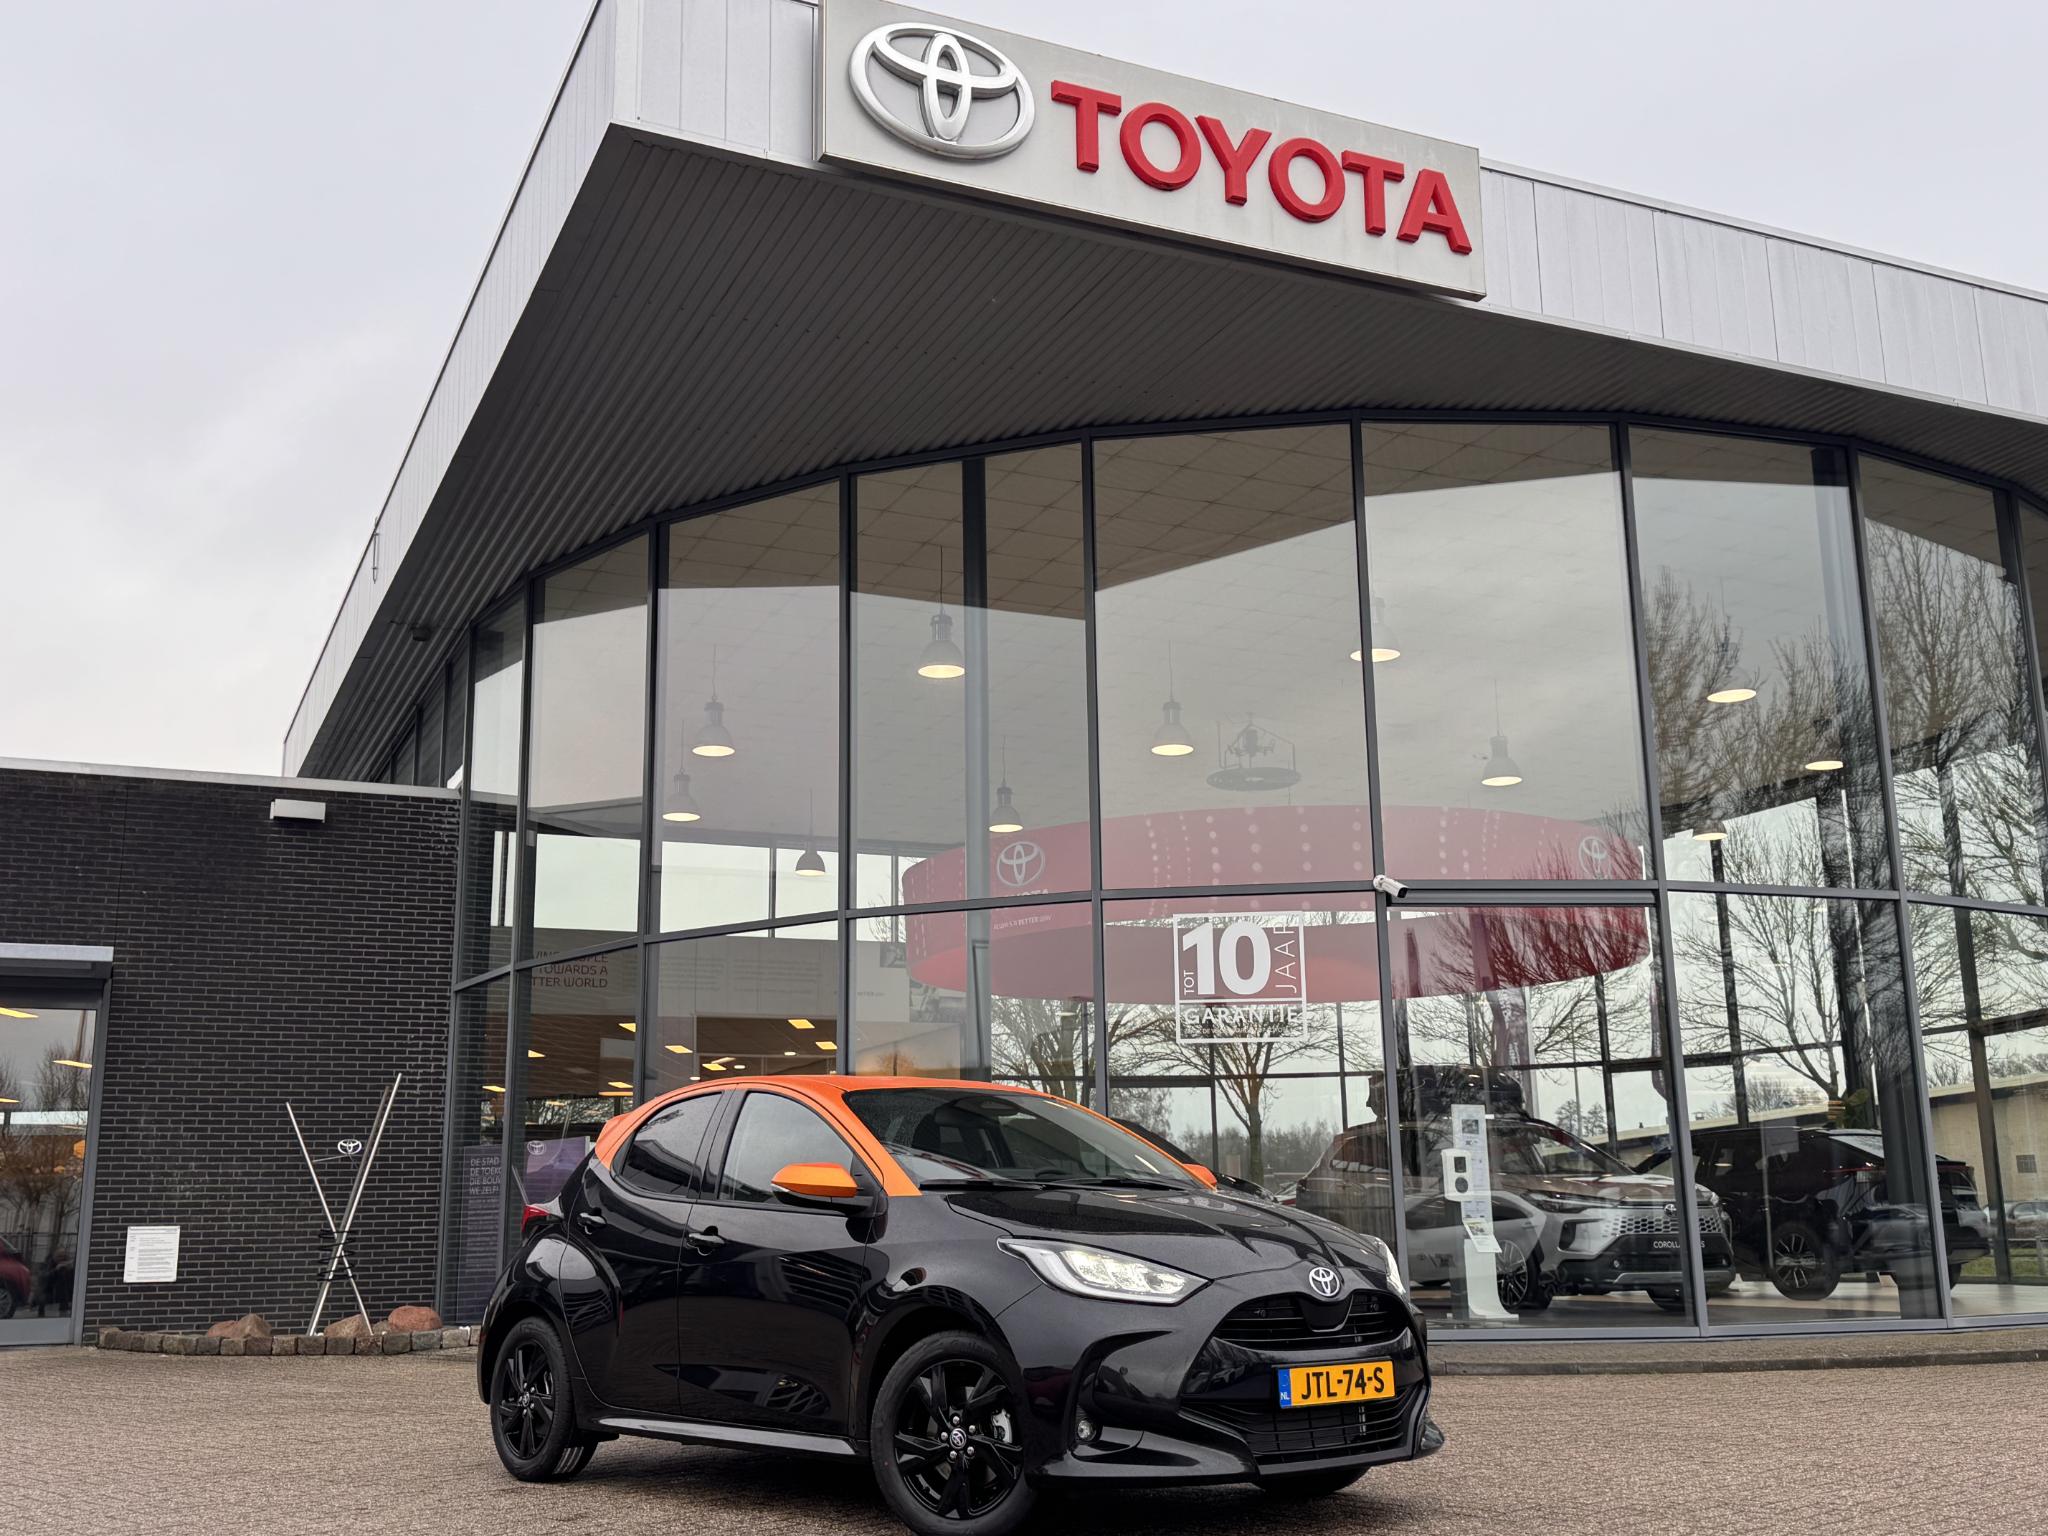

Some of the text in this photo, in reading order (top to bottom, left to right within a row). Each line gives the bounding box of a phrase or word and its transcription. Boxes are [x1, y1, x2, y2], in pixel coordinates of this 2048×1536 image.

[1051, 79, 1472, 255] TOYOTA
[1182, 919, 1271, 995] 10
[532, 977, 608, 988] TTER WORLD
[1183, 970, 1195, 996] TOT
[1184, 1006, 1298, 1024] GARANTIE
[1280, 1391, 1291, 1401] NL
[1301, 1367, 1385, 1400] JTL-74-S
